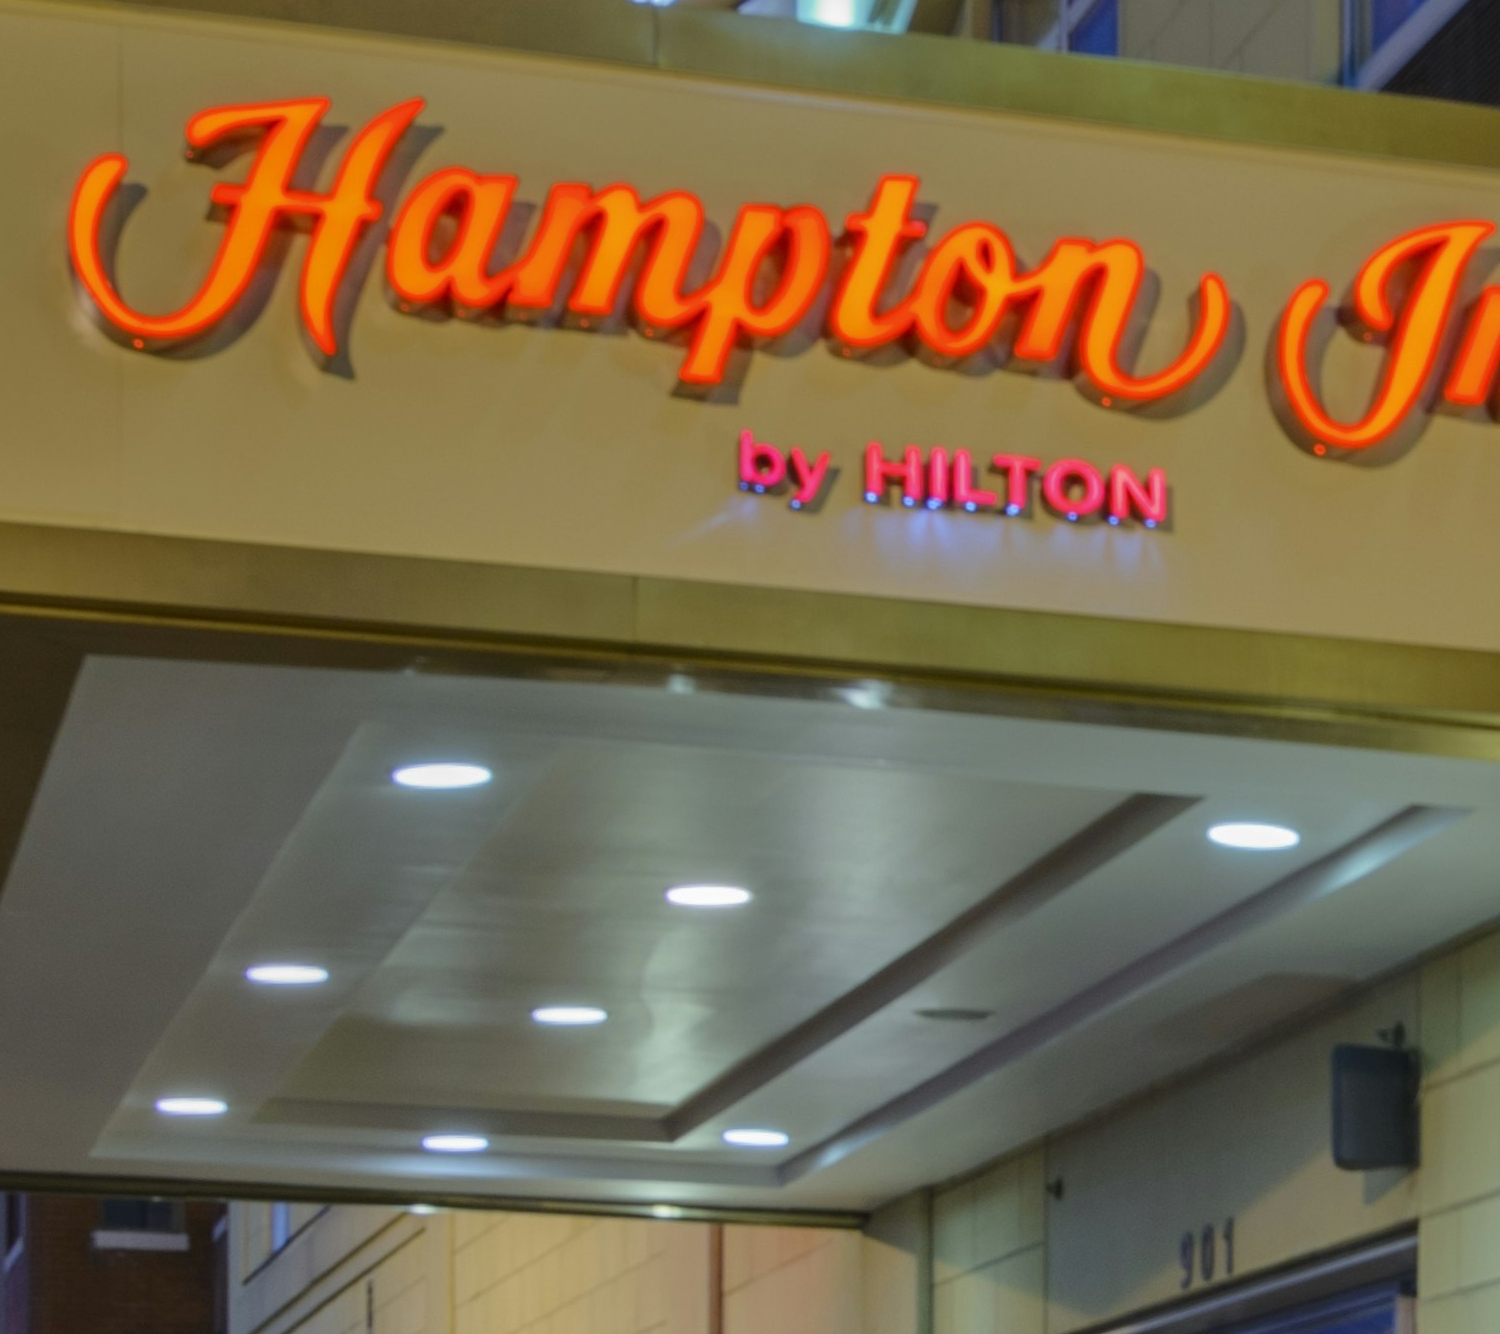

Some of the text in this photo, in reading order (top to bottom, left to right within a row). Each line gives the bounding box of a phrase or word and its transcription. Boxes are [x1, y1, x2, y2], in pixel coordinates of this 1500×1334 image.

[68, 96, 1229, 406] Hampton
[740, 428, 1168, 525] by HILTON
[1179, 1216, 1237, 1290] 901
